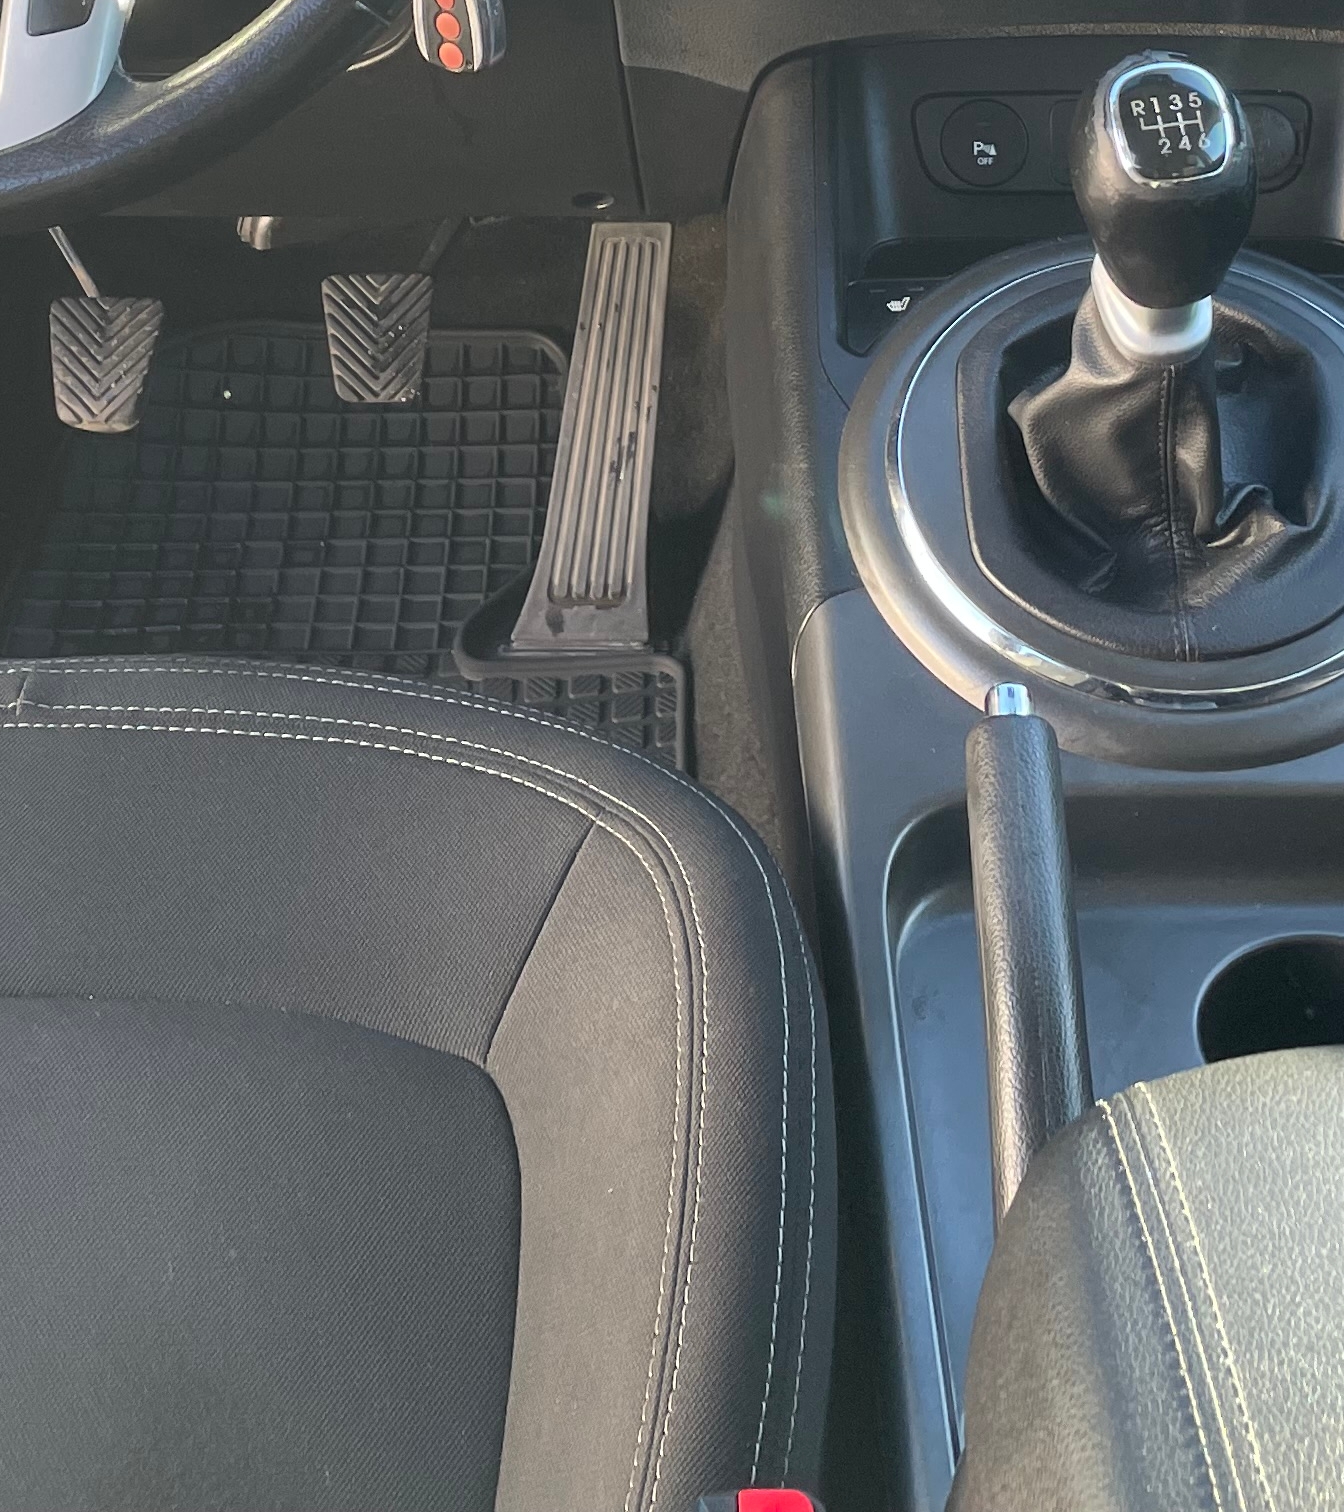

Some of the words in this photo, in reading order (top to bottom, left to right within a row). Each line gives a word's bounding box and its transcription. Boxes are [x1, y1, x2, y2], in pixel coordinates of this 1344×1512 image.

[1130, 99, 1146, 117] R
[1149, 96, 1161, 114] 1
[1168, 94, 1183, 111] 3
[1188, 92, 1202, 108] 5
[1158, 138, 1173, 155] 2
[1178, 135, 1193, 151] 4
[1198, 132, 1211, 149] 6
[977, 157, 994, 166] OFF
